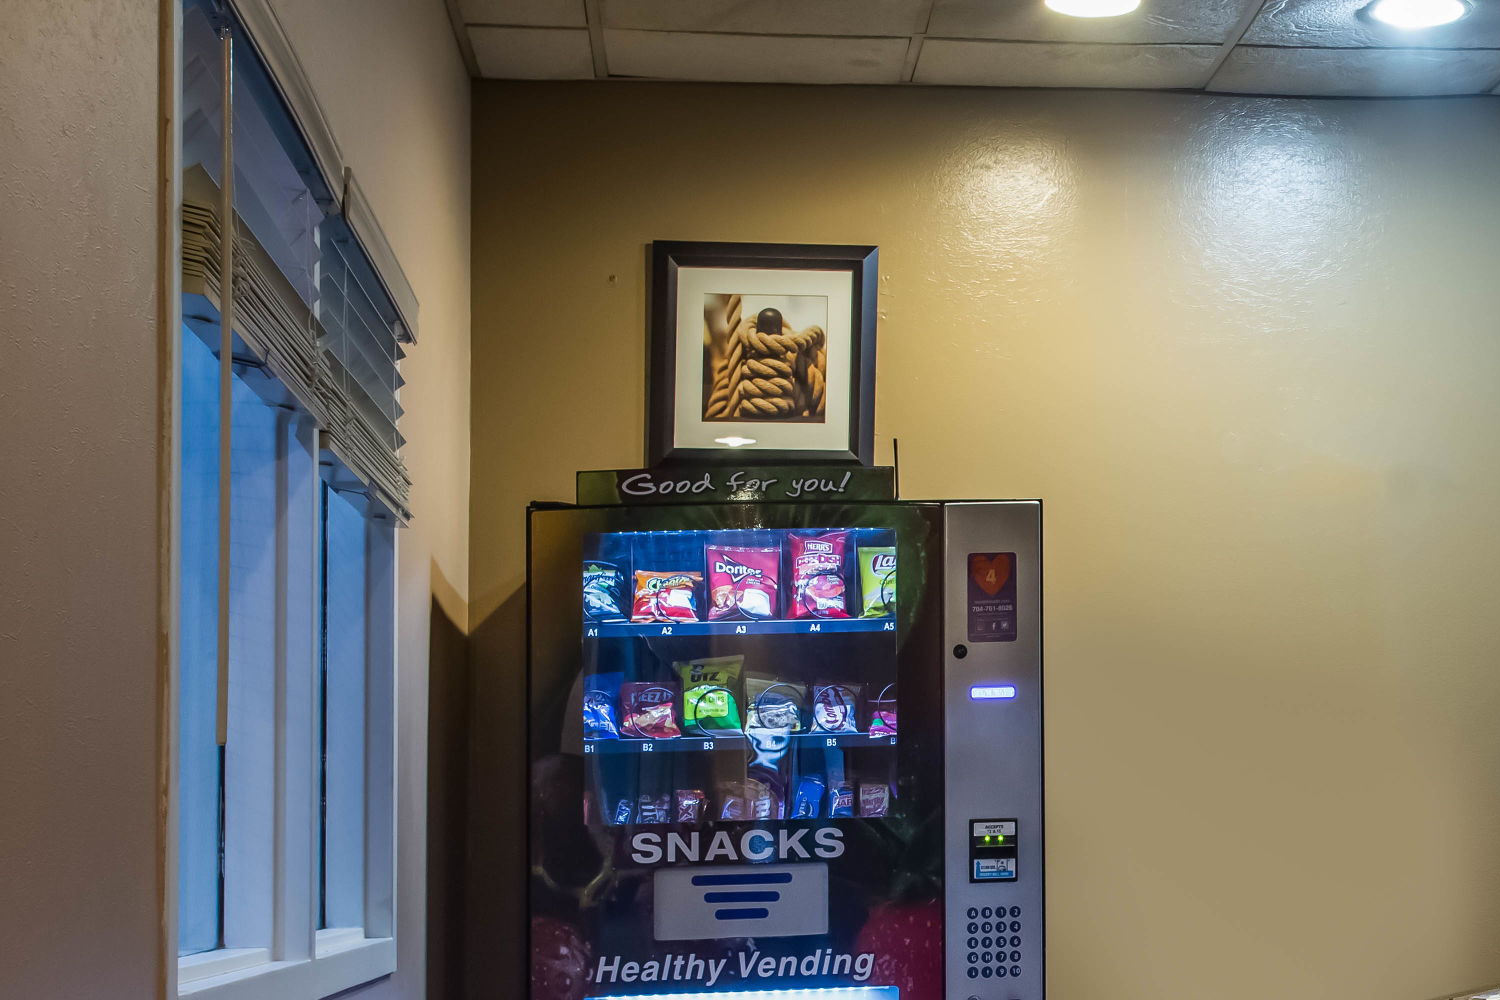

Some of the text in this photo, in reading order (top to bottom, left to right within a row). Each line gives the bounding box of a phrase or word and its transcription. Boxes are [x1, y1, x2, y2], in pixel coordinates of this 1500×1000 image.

[622, 472, 852, 497] Good for you!
[875, 555, 896, 570] La
[715, 561, 762, 577] Doritos
[736, 625, 746, 634] A3
[810, 624, 820, 632] A4
[884, 622, 894, 630] A5
[588, 629, 598, 637] A1
[661, 627, 672, 635] A2
[643, 744, 653, 752] B2
[703, 742, 714, 750] B3
[632, 827, 845, 864] SNACKS
[595, 949, 875, 986] Healthy Vending
